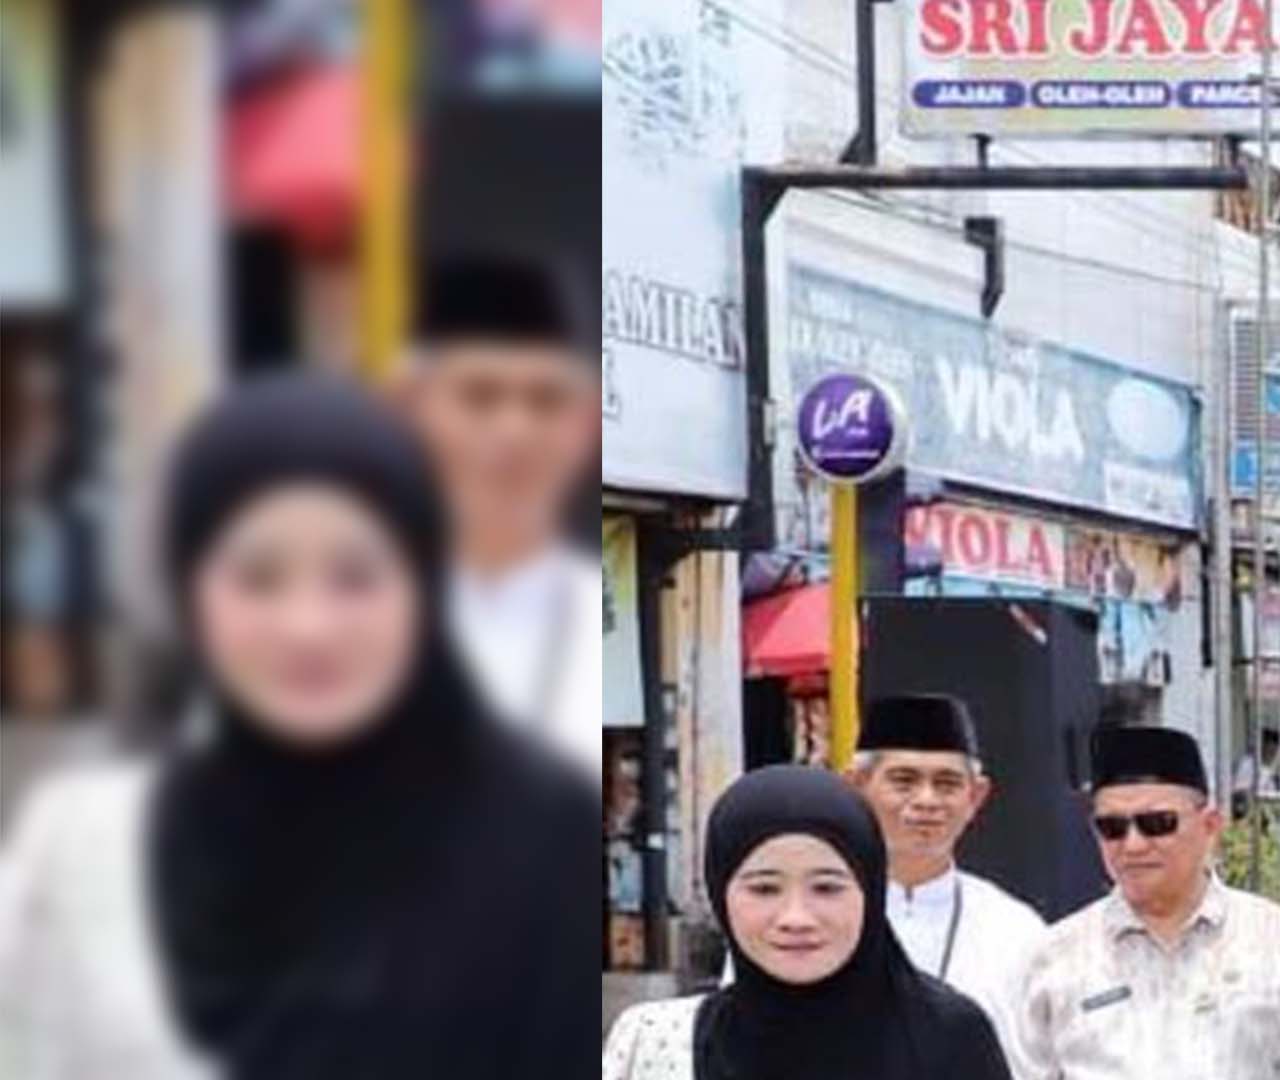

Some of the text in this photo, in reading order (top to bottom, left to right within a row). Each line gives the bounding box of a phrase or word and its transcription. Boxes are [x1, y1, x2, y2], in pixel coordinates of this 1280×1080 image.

[920, 0, 1279, 54] SRI JAYA
[935, 356, 1086, 462] VIOLA
